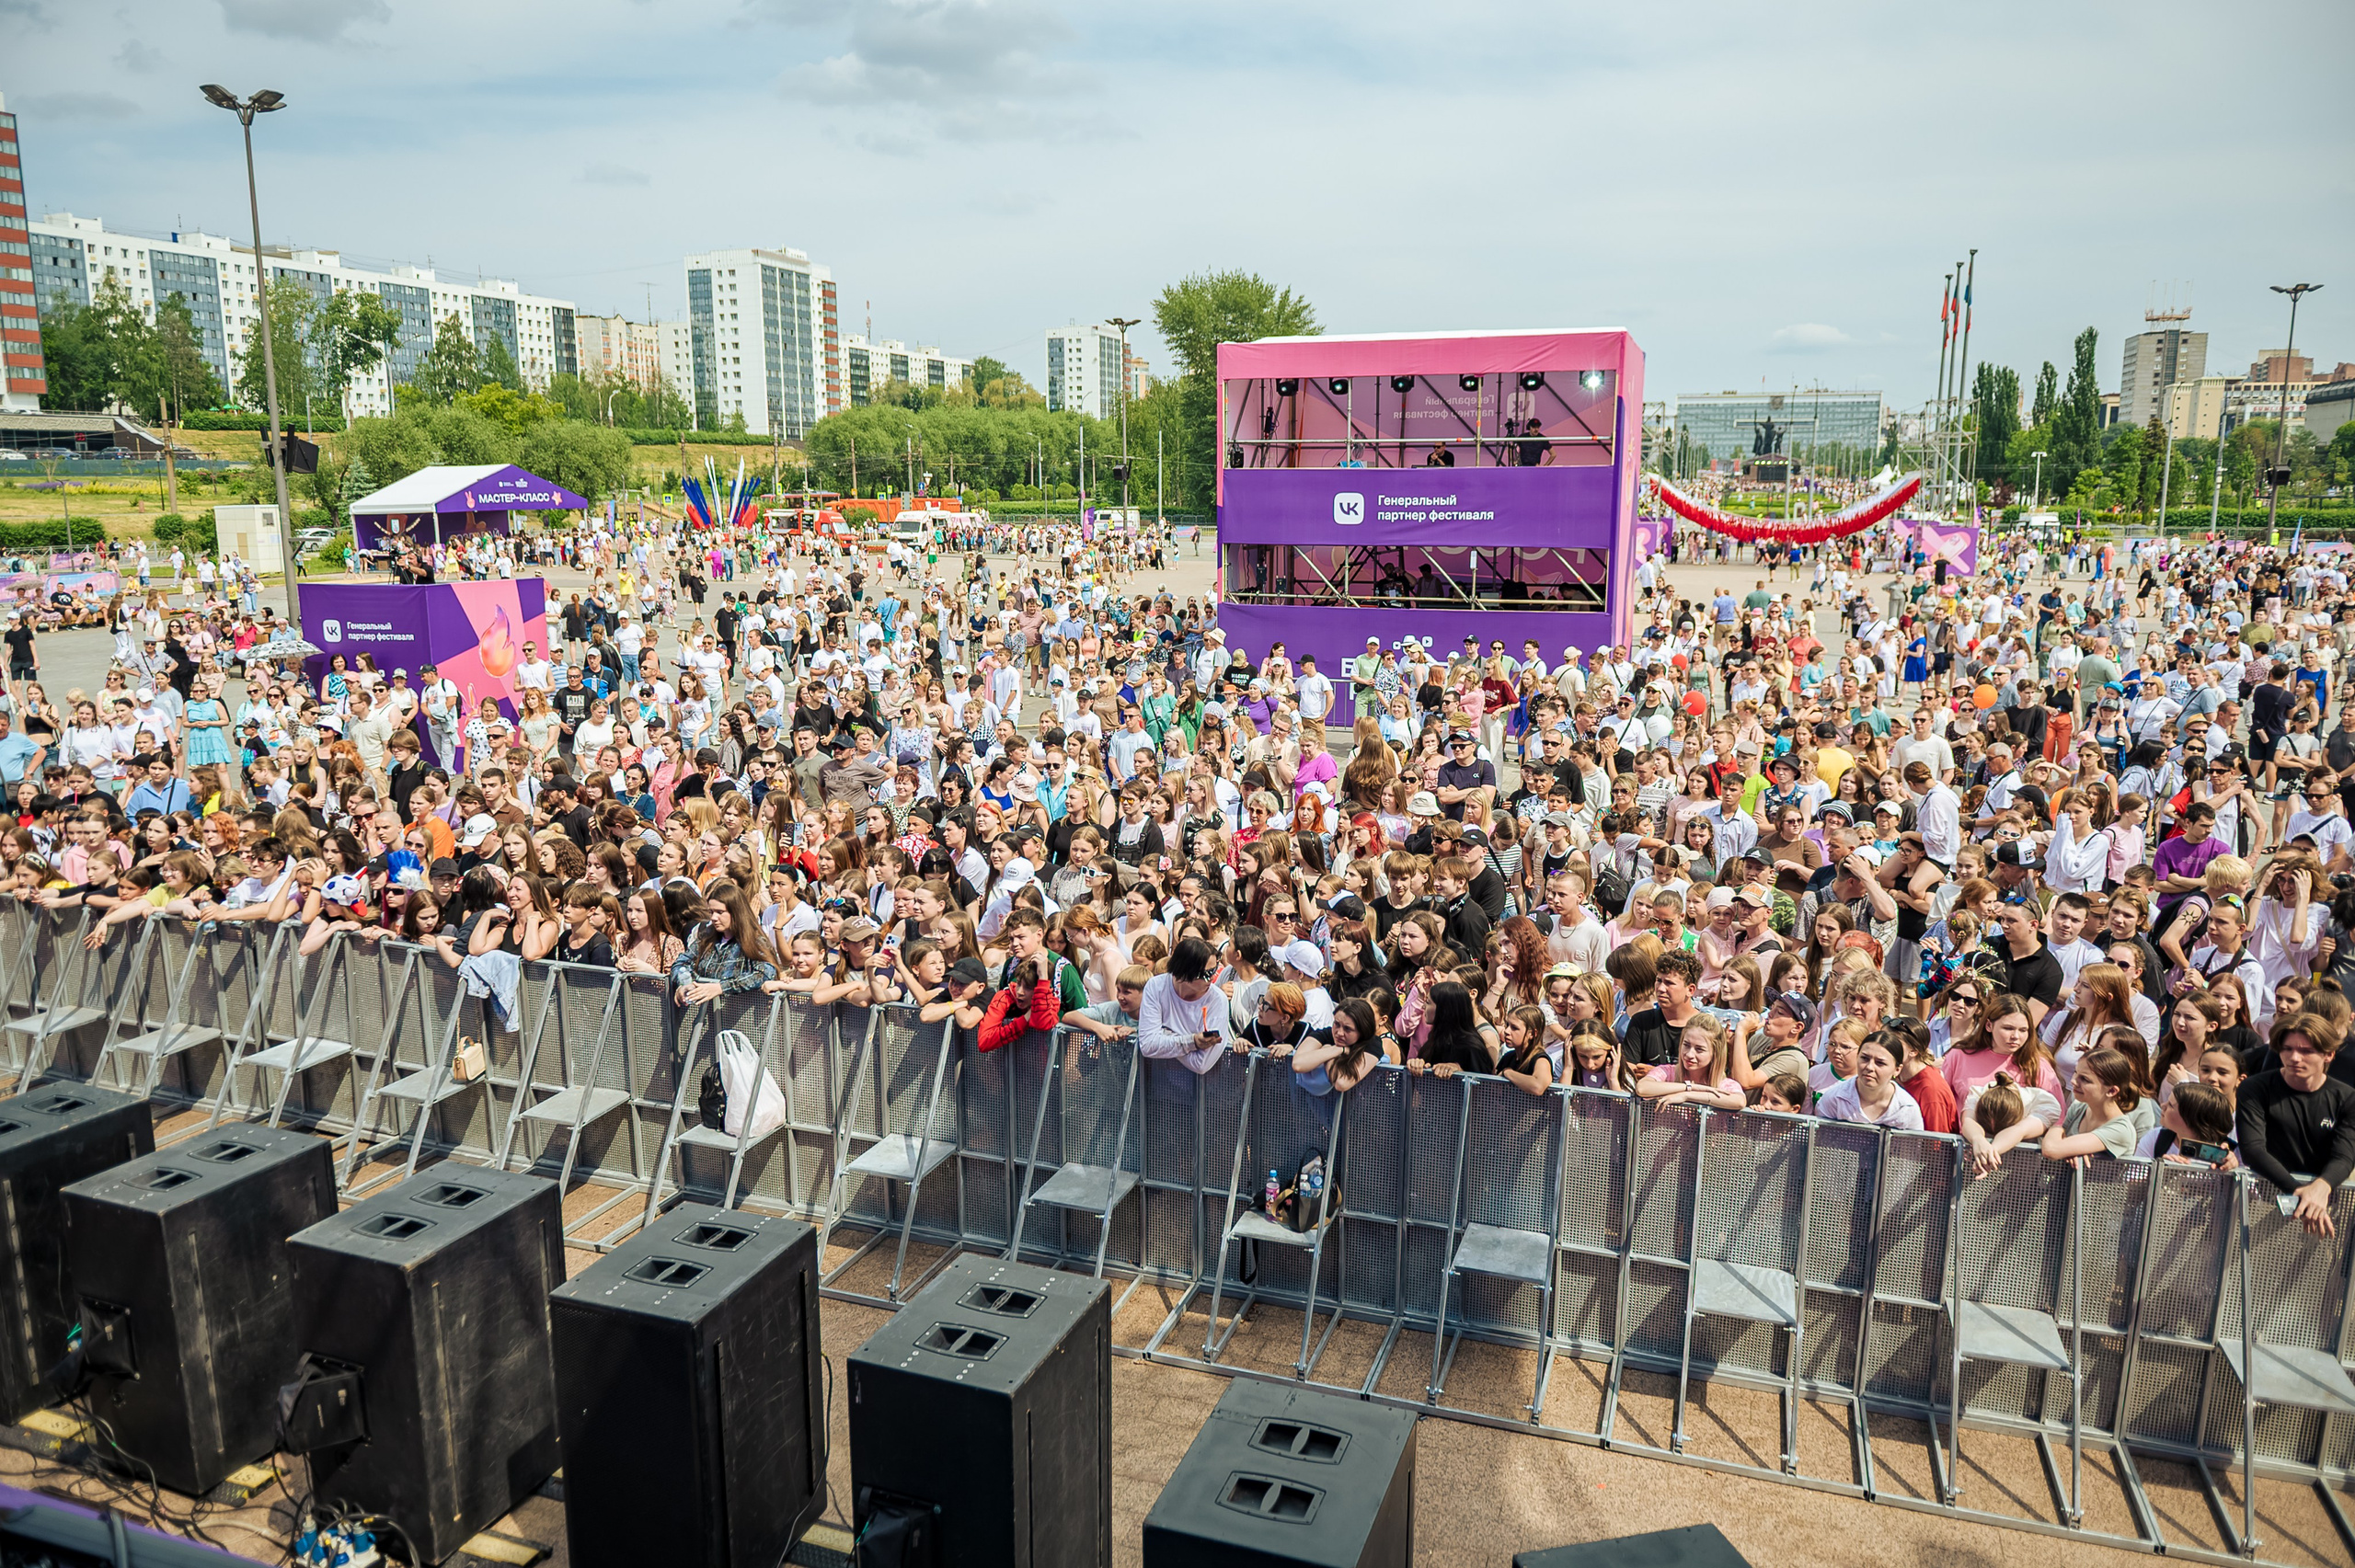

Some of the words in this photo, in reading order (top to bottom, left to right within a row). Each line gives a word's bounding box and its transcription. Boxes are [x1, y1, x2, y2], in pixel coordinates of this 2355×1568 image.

[478, 492, 550, 504] МАСТЕР-КЛАСС
[1377, 495, 1456, 508] Генеральный
[1339, 502, 1359, 515] VK
[1377, 511, 1426, 522] партнер
[1429, 509, 1494, 522] фестиваля
[346, 622, 393, 631] Генеральный
[348, 633, 376, 641] партнер
[376, 633, 415, 641] фестиваля
